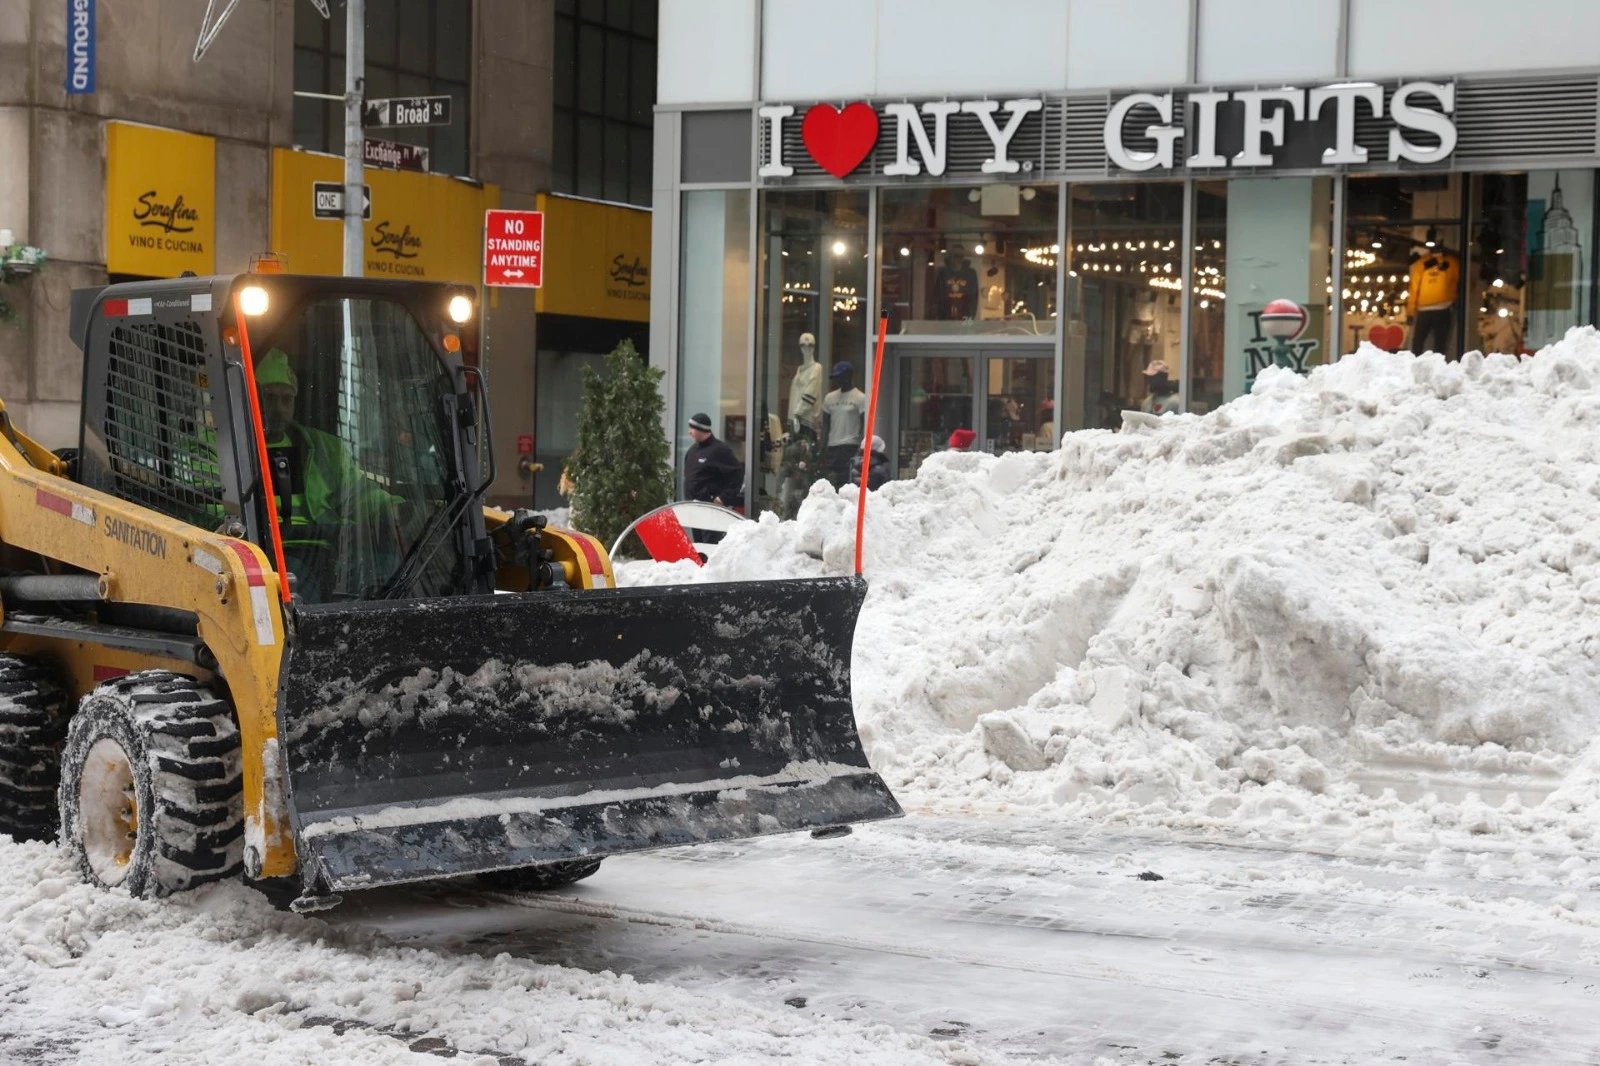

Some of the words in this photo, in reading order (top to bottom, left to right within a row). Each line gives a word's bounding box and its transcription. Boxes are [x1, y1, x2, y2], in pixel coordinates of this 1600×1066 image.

[73, 0, 89, 90] GROUND
[396, 104, 430, 125] Broad
[434, 102, 442, 116] St
[758, 105, 794, 177] I
[1103, 82, 1458, 171] GIFTS
[365, 141, 402, 167] Exchange
[319, 194, 337, 208] ONE
[133, 190, 199, 234] Serafina
[504, 219, 525, 235] NO
[129, 234, 155, 249] VINO
[157, 238, 163, 250] E
[165, 239, 204, 253] CUCINA
[371, 221, 422, 259] Serafina
[488, 238, 541, 252] STANDING
[367, 260, 387, 273] VINO
[388, 261, 395, 274] E
[395, 263, 426, 277] CUCINA
[490, 254, 538, 268] ANYTIME
[961, 315, 974, 327] 26
[104, 515, 167, 560] SANITATION
